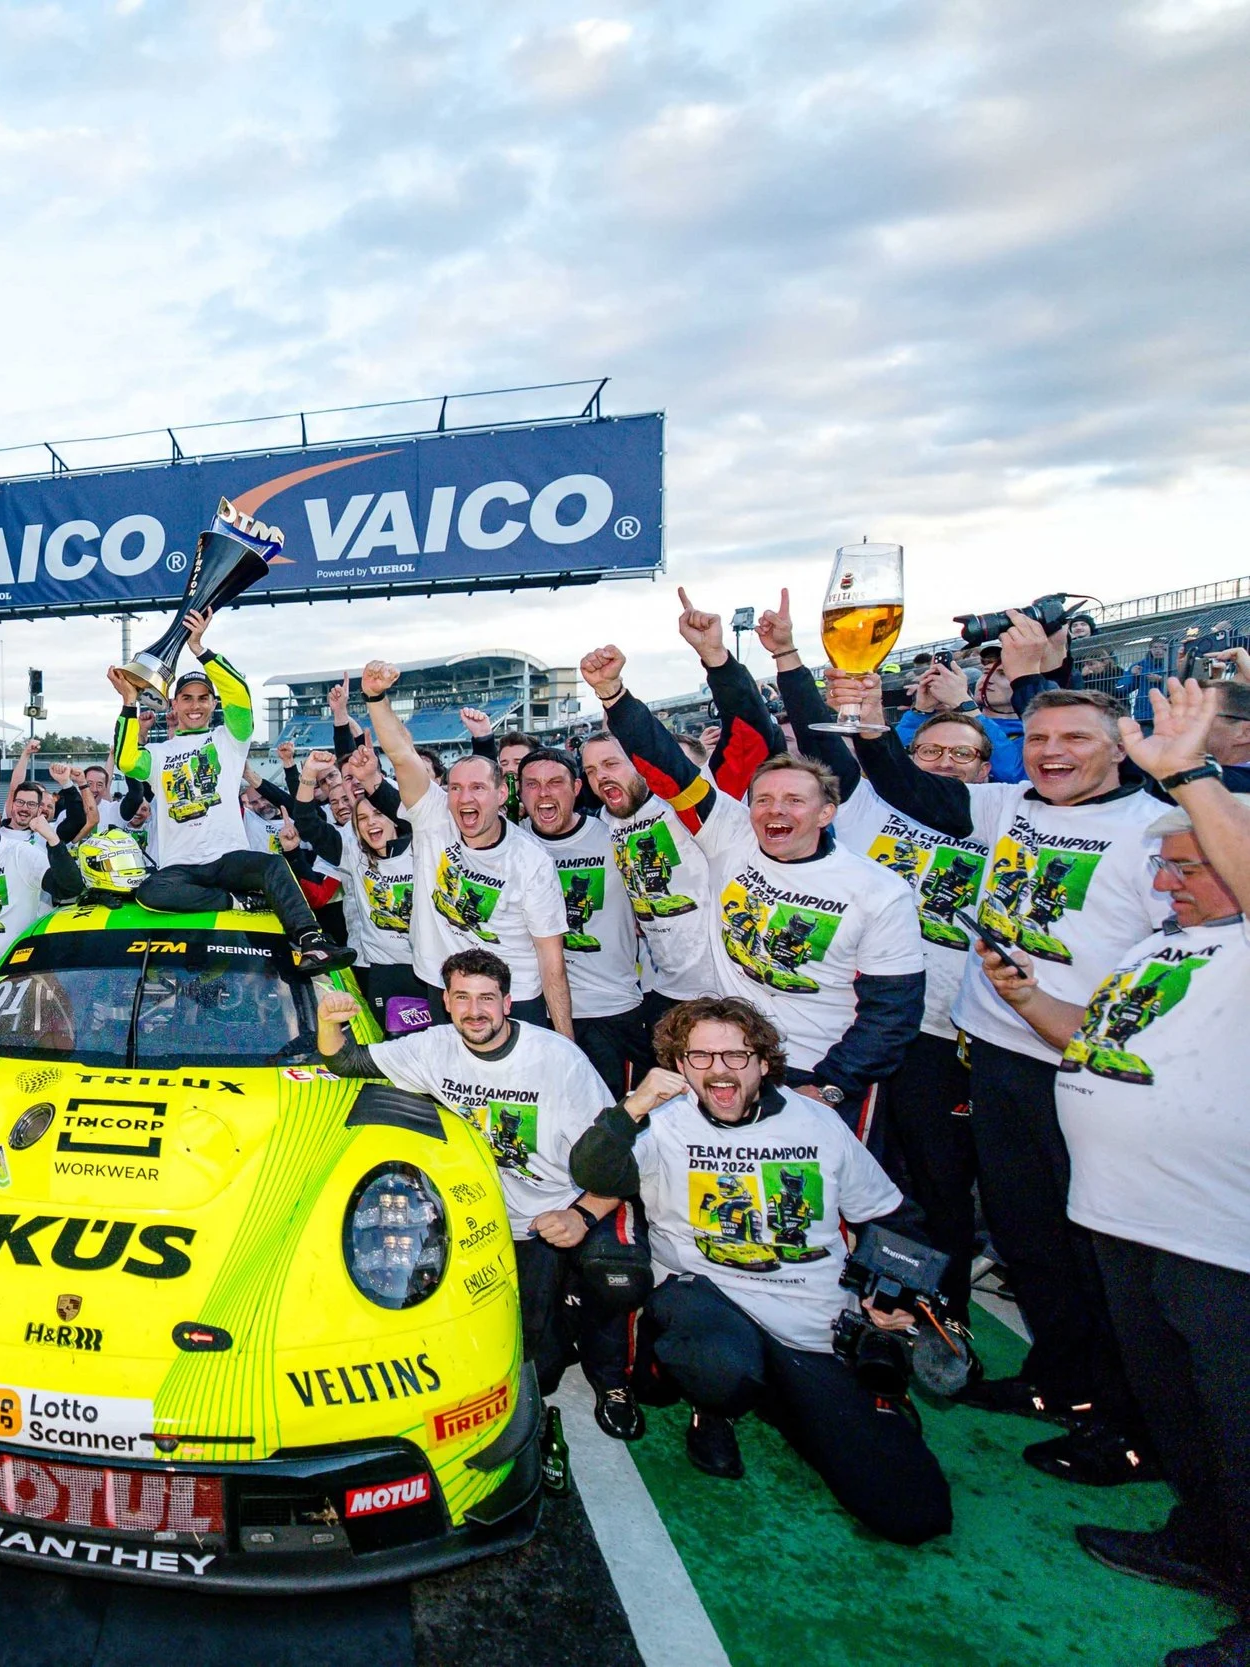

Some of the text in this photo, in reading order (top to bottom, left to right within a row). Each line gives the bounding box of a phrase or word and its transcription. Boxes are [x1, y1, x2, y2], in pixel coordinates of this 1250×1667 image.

[303, 473, 614, 562] VAICO
[316, 563, 416, 579] Powered by VIEROL
[881, 825, 906, 838] DTM
[99, 848, 141, 861] PORSC
[920, 832, 990, 857] CHAMPIO
[382, 874, 414, 885] CHAMP
[126, 940, 273, 958] DTM PREINING
[408, 1009, 432, 1026] KW
[75, 1072, 246, 1096] TRILUX
[441, 1077, 472, 1096] TEAM
[463, 1095, 488, 1107] 2026
[63, 1115, 165, 1132] TRICORP
[687, 1144, 819, 1161] TEAM CHAMPION
[54, 1161, 159, 1182] WORKWEAR
[689, 1159, 756, 1174] DTM 2026
[458, 1219, 500, 1251] PADDOCK
[463, 1262, 498, 1295] ENDLESS
[750, 1276, 806, 1285] MANTHEY
[24, 1321, 73, 1347] H&R
[286, 1352, 441, 1409] VELTINS
[29, 1393, 99, 1424] Lotto
[433, 1383, 508, 1441] PIRELLI
[29, 1420, 137, 1452] Scanner
[350, 1477, 427, 1514] MOTUL
